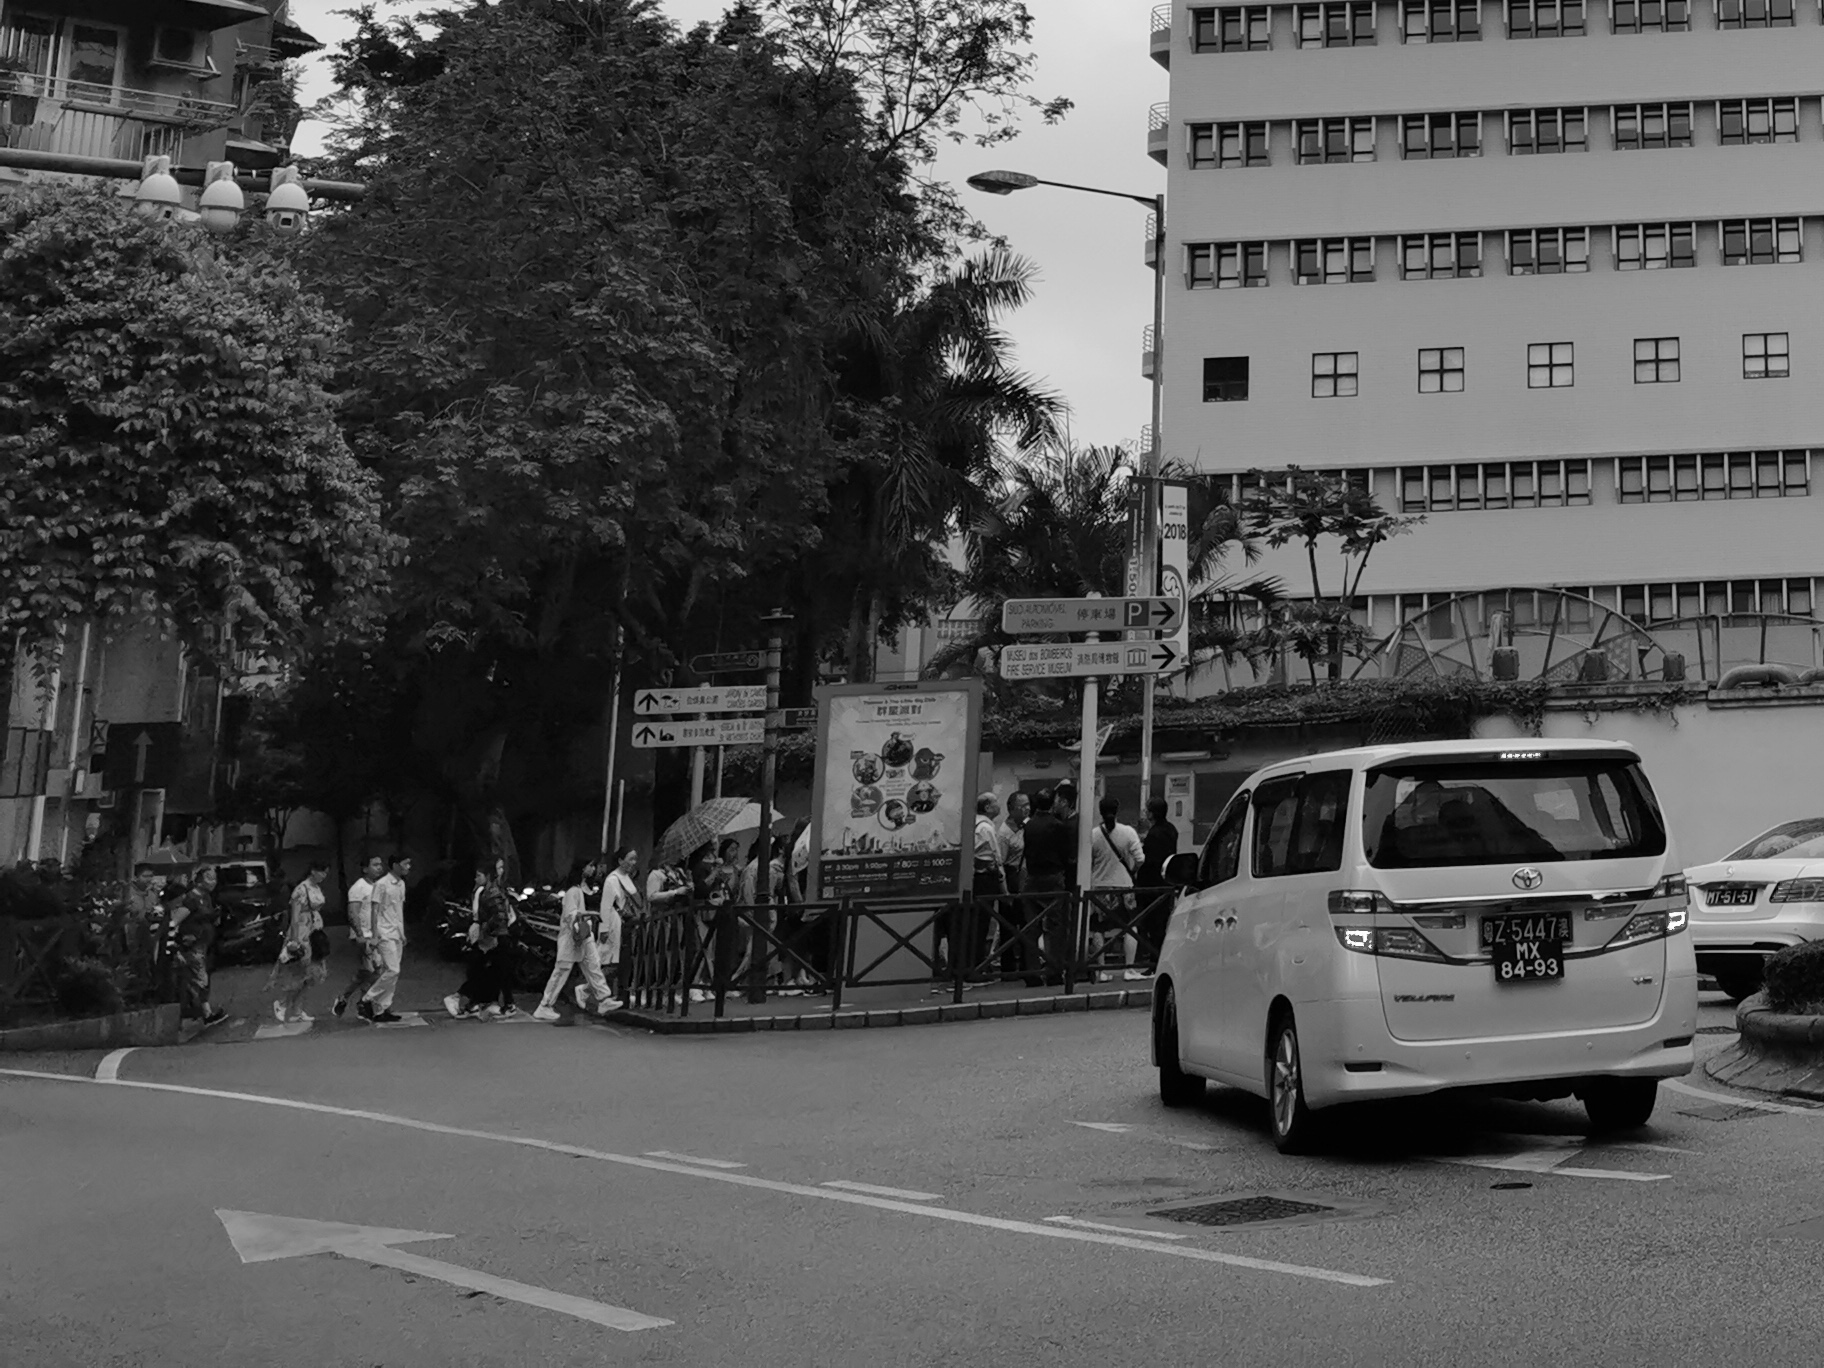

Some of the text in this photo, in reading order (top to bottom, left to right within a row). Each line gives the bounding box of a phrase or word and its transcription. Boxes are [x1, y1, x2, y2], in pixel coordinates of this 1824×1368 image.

[1164, 523, 1186, 540] 2018
[1128, 603, 1142, 625] P
[1516, 941, 1541, 960] MX
[1501, 958, 1558, 979] 84-93
